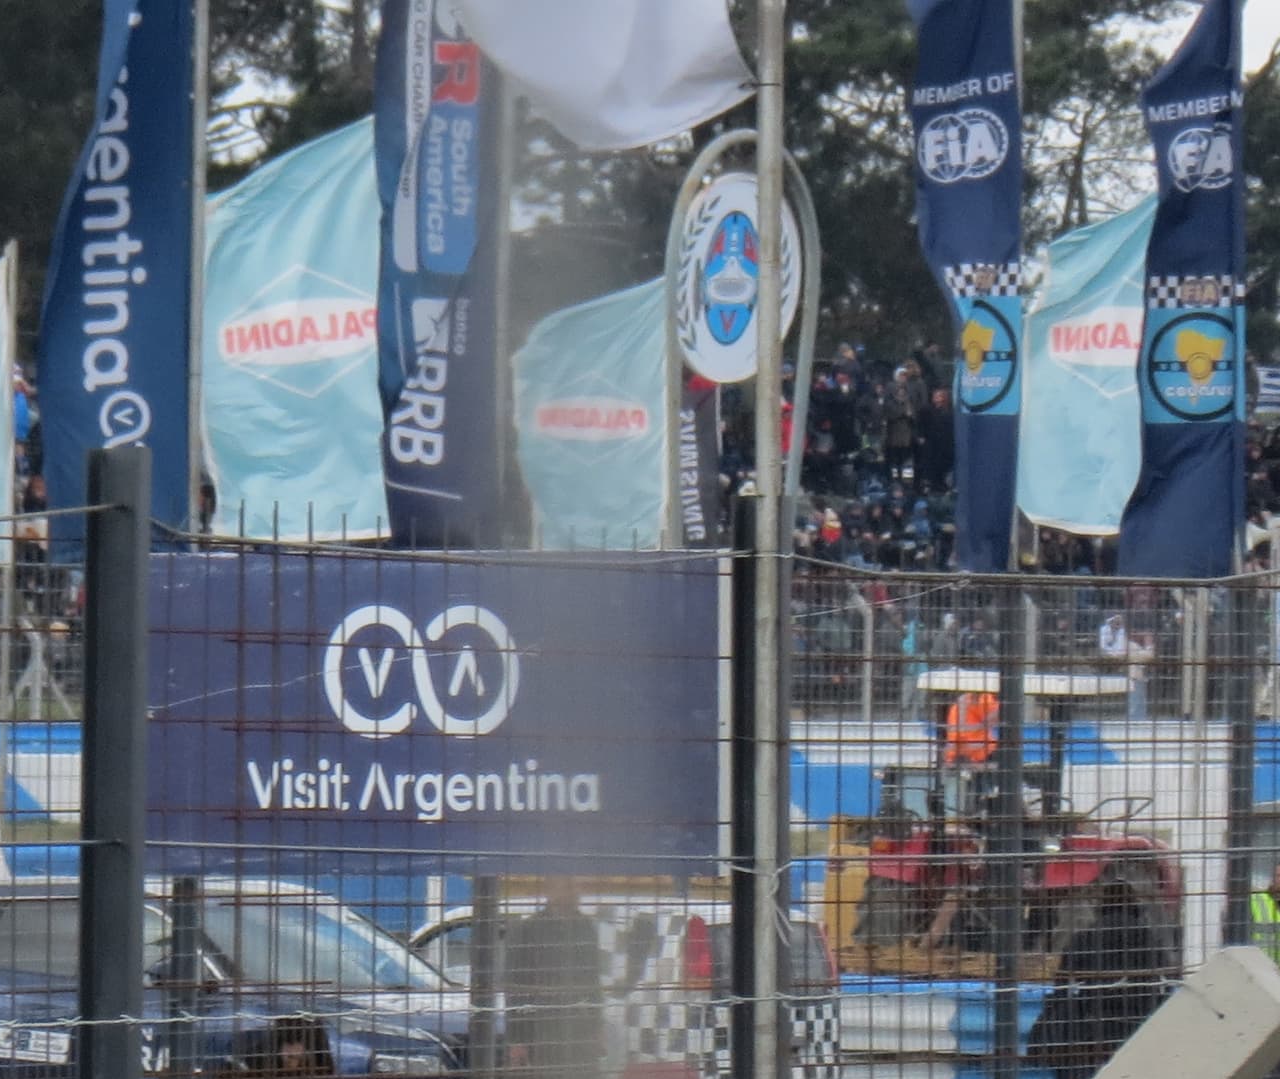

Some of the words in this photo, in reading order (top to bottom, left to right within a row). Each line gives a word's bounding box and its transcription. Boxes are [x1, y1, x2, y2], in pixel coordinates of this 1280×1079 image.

[913, 78, 982, 105] MEMBER
[986, 72, 1015, 93] OF
[84, 12, 147, 391] gentina
[248, 758, 349, 812] Visit
[361, 758, 600, 822] Argentina
